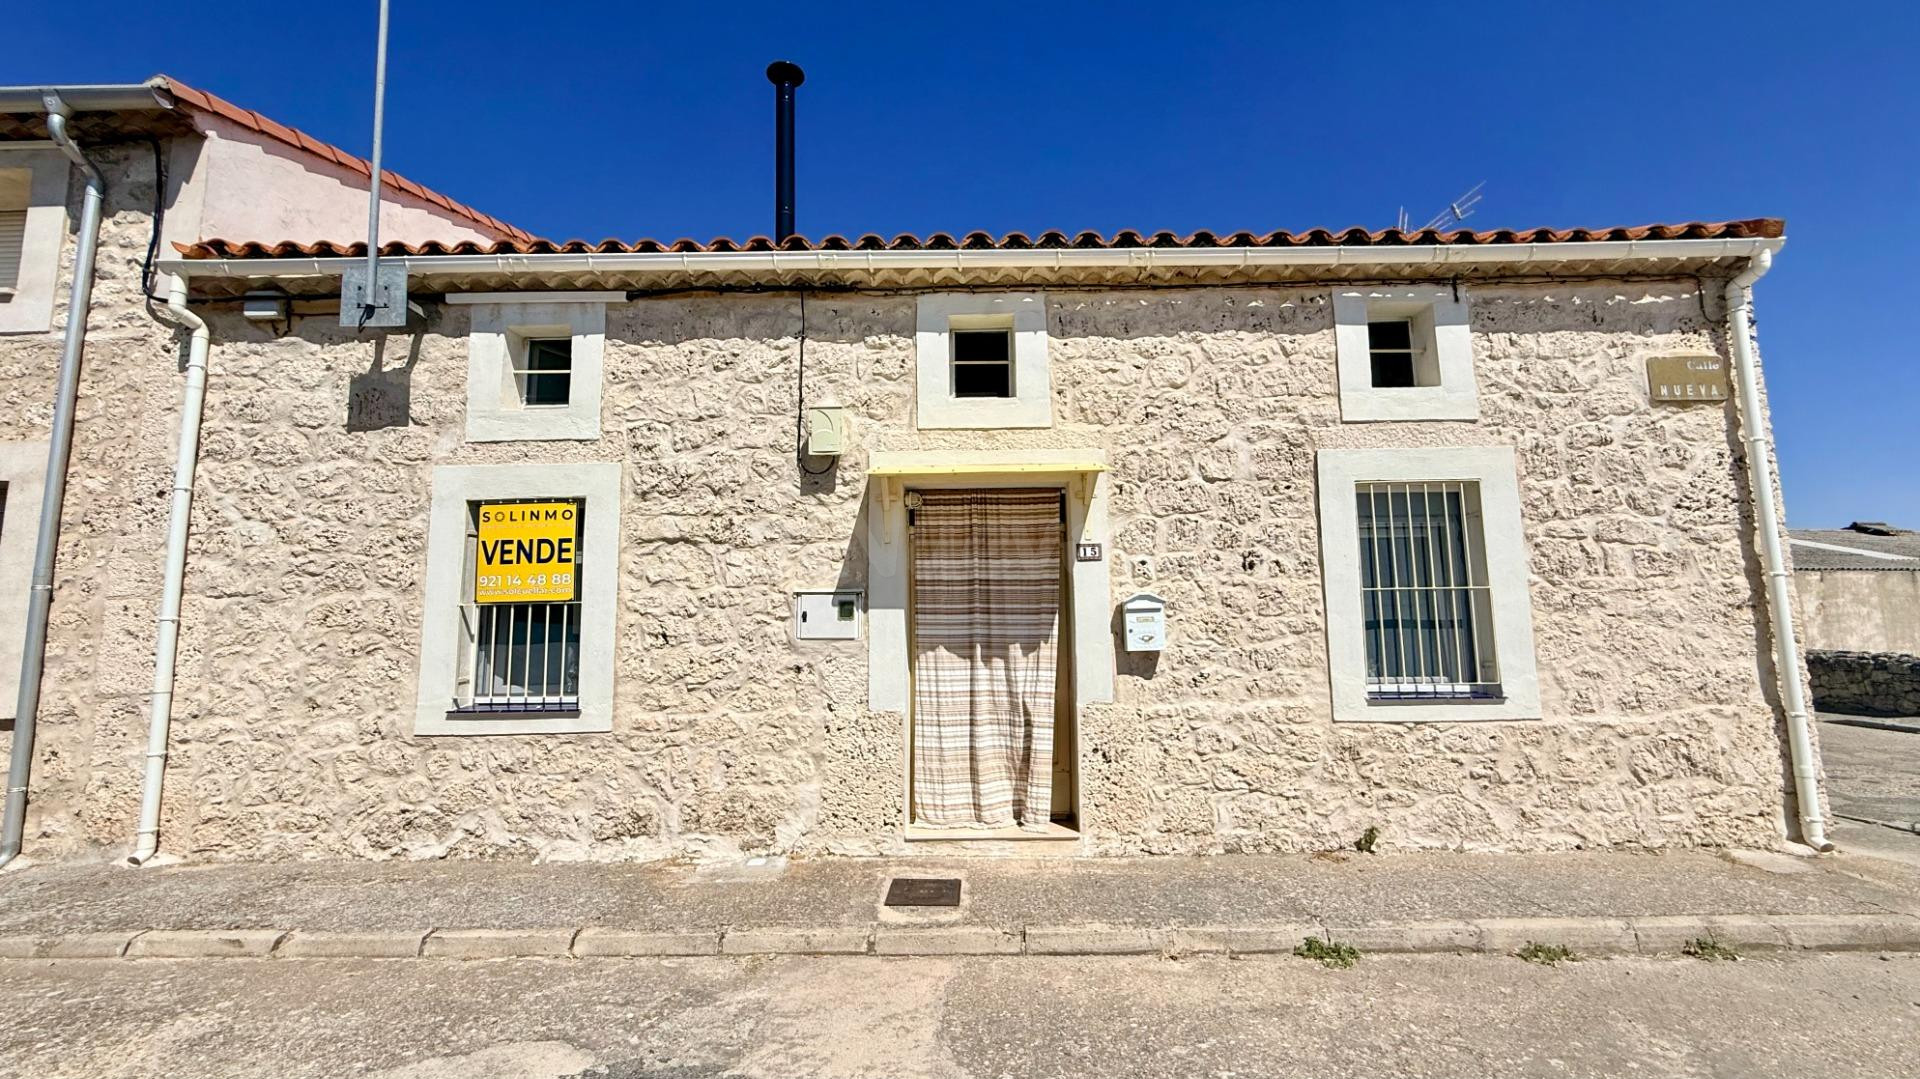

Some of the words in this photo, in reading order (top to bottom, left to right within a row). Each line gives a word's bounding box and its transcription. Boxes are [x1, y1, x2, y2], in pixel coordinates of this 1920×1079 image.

[1659, 384, 1719, 396] NUEVA
[482, 509, 574, 523] SOLINMO
[481, 537, 573, 566] VENDE
[1083, 547, 1097, 556] 15
[479, 575, 502, 587] 921
[506, 574, 521, 586] 14
[527, 573, 547, 586] 48
[551, 573, 572, 585] 88
